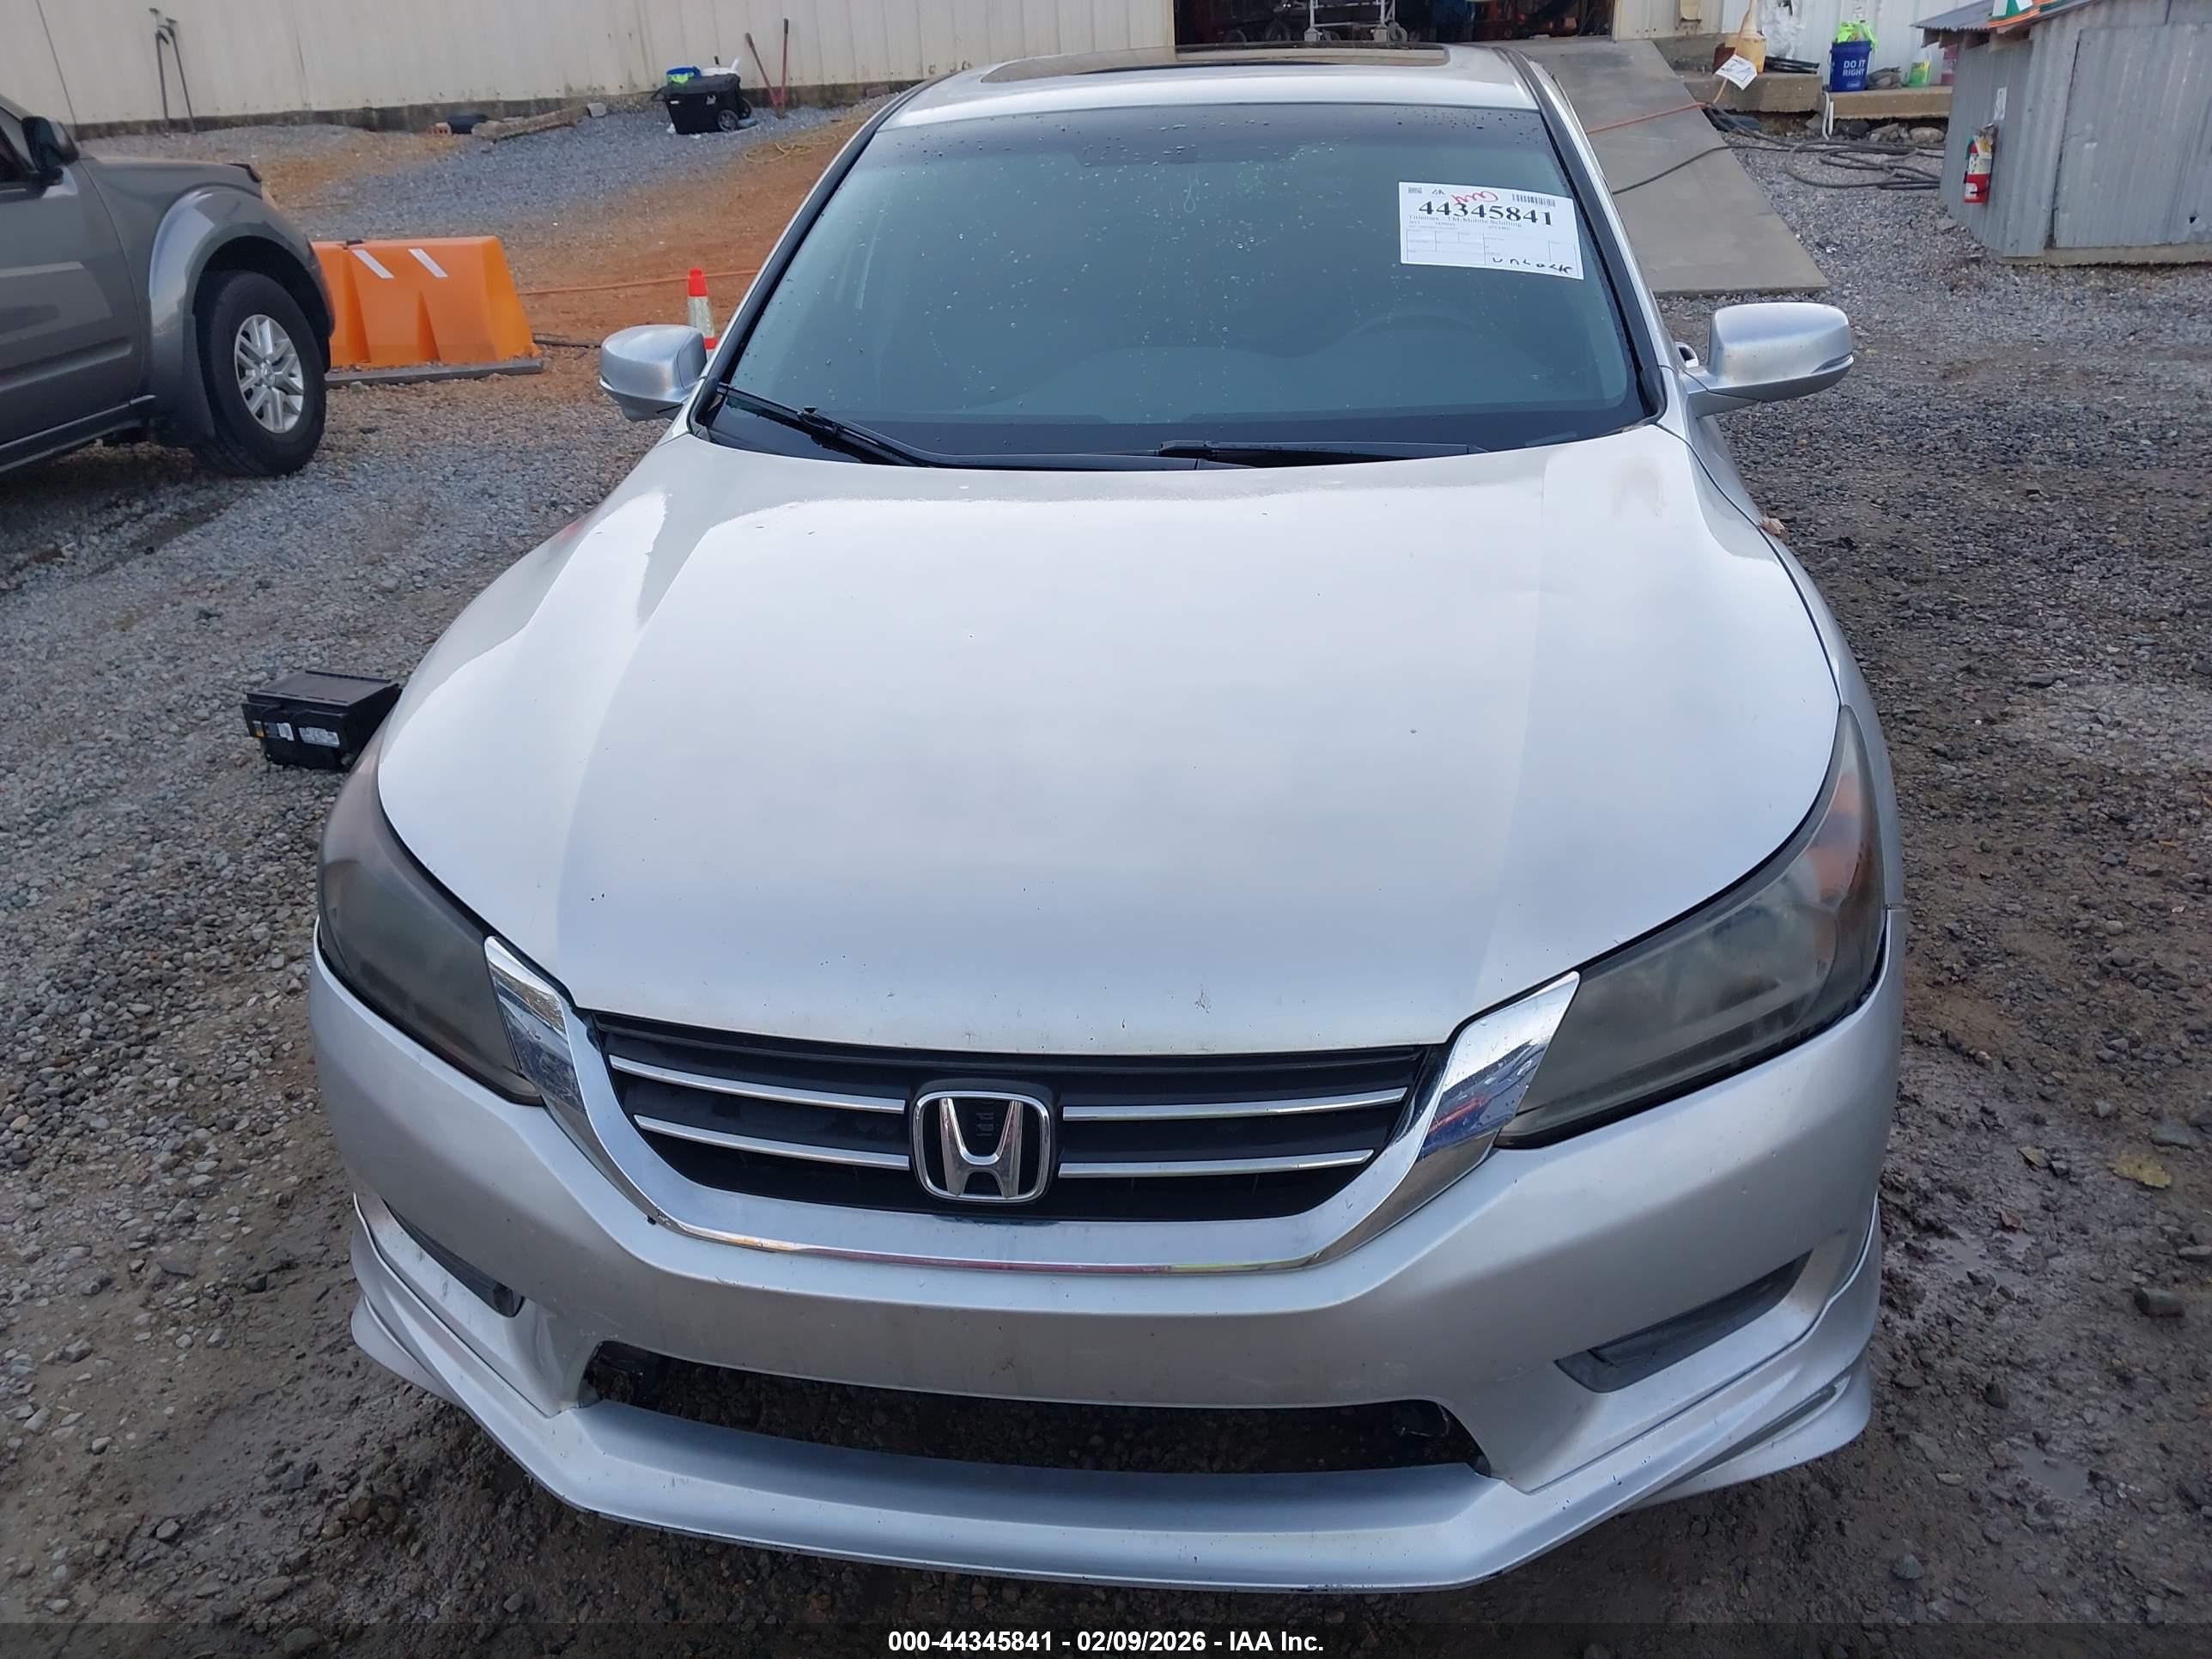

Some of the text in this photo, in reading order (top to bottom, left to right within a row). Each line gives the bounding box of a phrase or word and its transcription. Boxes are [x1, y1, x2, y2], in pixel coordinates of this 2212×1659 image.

[1843, 59, 1866, 69] DO IT
[1842, 68, 1865, 76] RIGHT
[1419, 200, 1553, 226] 44345841
